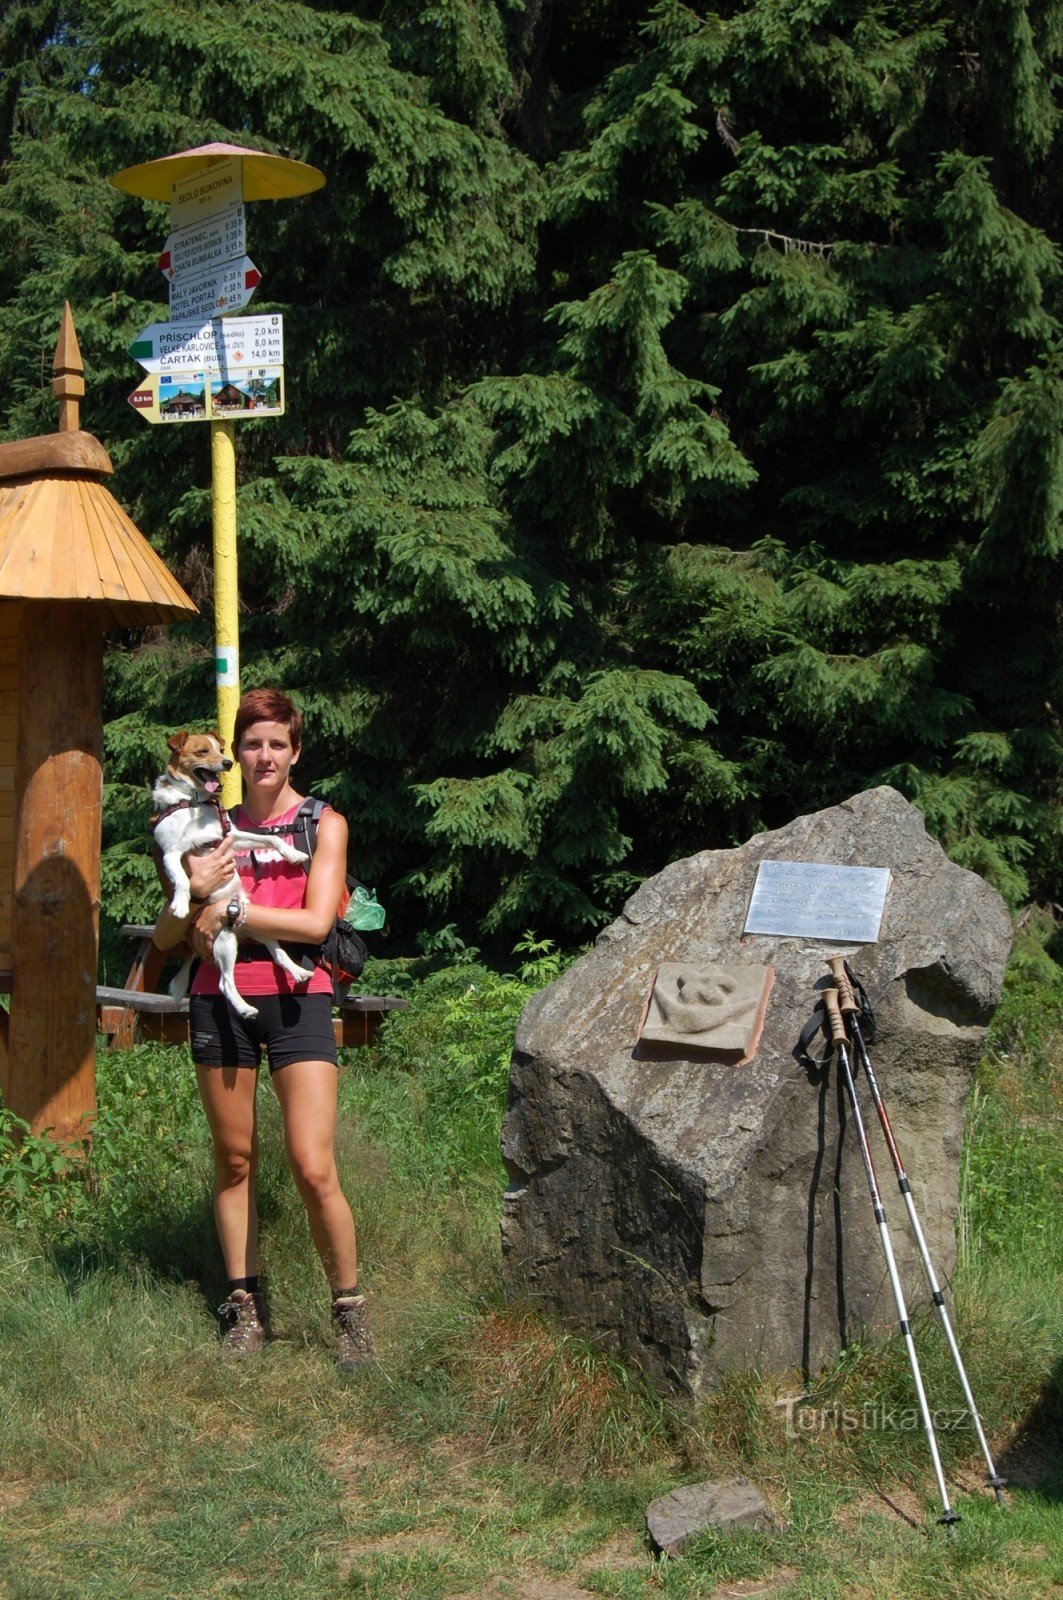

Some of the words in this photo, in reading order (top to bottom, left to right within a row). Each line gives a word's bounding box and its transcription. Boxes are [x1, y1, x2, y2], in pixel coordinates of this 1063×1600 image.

[200, 176, 233, 196] BUKOVINA
[172, 299, 191, 311] HOTEL
[220, 331, 245, 340] (sedlo)
[255, 327, 266, 337] 2,0
[268, 326, 280, 335] km
[159, 343, 180, 354] VELKÉ
[183, 341, 220, 353] KARLOVICE
[255, 338, 266, 348] 8,0
[268, 337, 280, 346] km
[160, 354, 201, 365] ČARTÁK
[203, 354, 224, 363] (BUS)
[251, 350, 266, 359] 14,0
[268, 349, 280, 358] km
